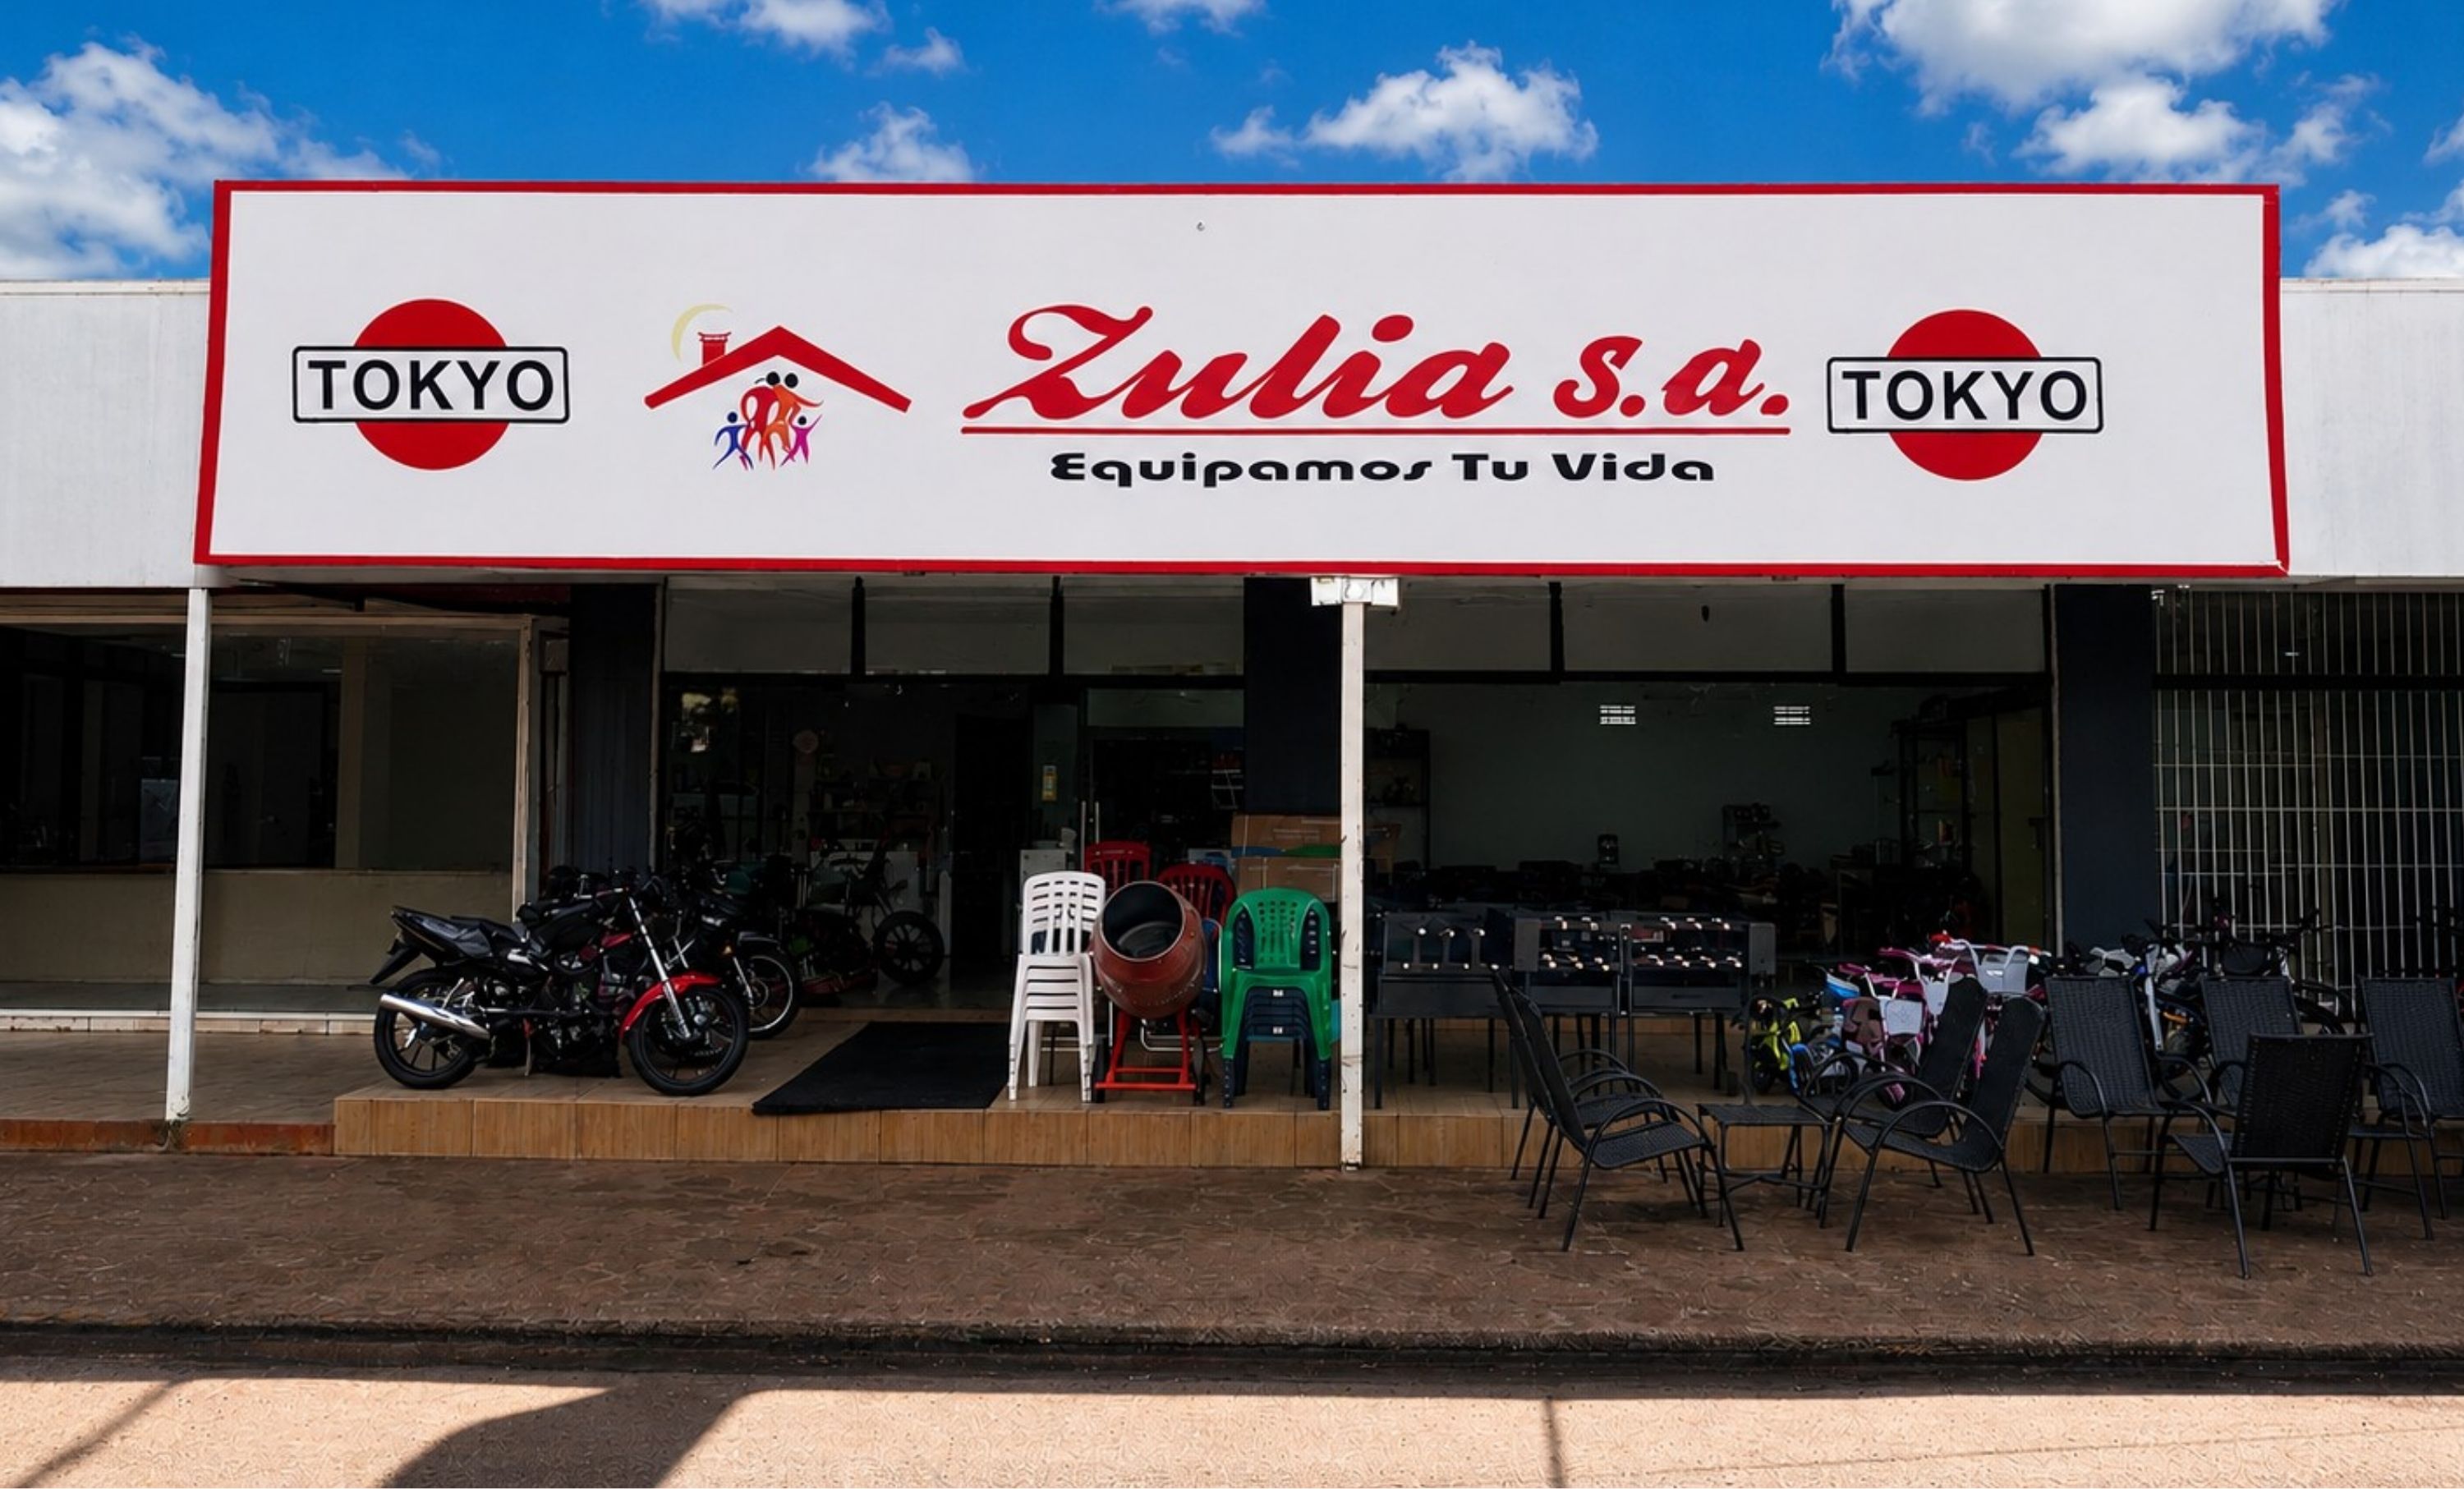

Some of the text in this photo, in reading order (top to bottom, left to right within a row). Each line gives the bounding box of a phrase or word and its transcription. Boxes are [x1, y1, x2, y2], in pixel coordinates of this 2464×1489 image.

[307, 359, 554, 412] TOKYO
[963, 304, 1790, 421] Zulia s.a.
[1841, 370, 2088, 421] TOKYO
[1050, 452, 1715, 488] Equipamos Tu Vida
